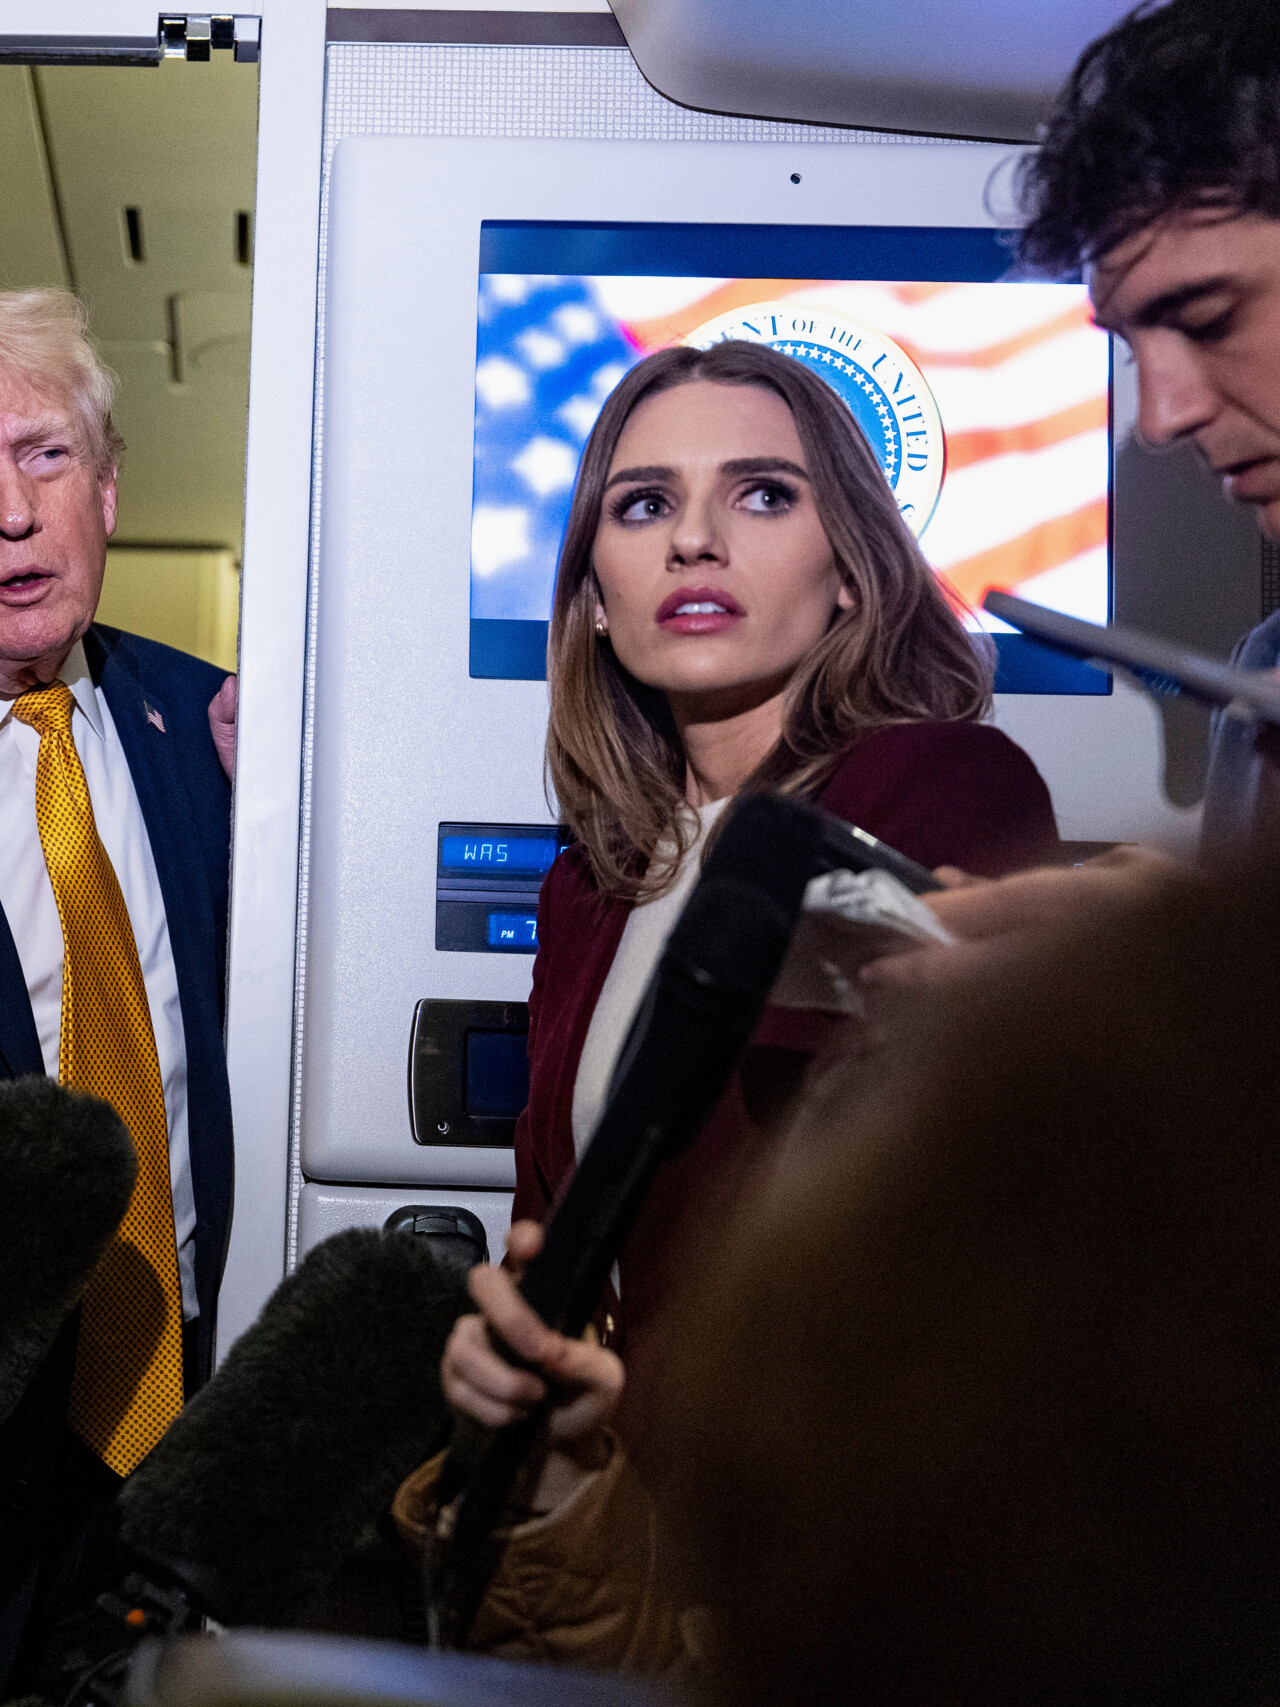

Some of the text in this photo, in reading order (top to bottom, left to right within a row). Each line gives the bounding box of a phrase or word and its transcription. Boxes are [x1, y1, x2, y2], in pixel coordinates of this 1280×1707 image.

[705, 314, 928, 472] ENT OF THE UNITED
[464, 843, 508, 862] WAS
[500, 930, 515, 939] PM
